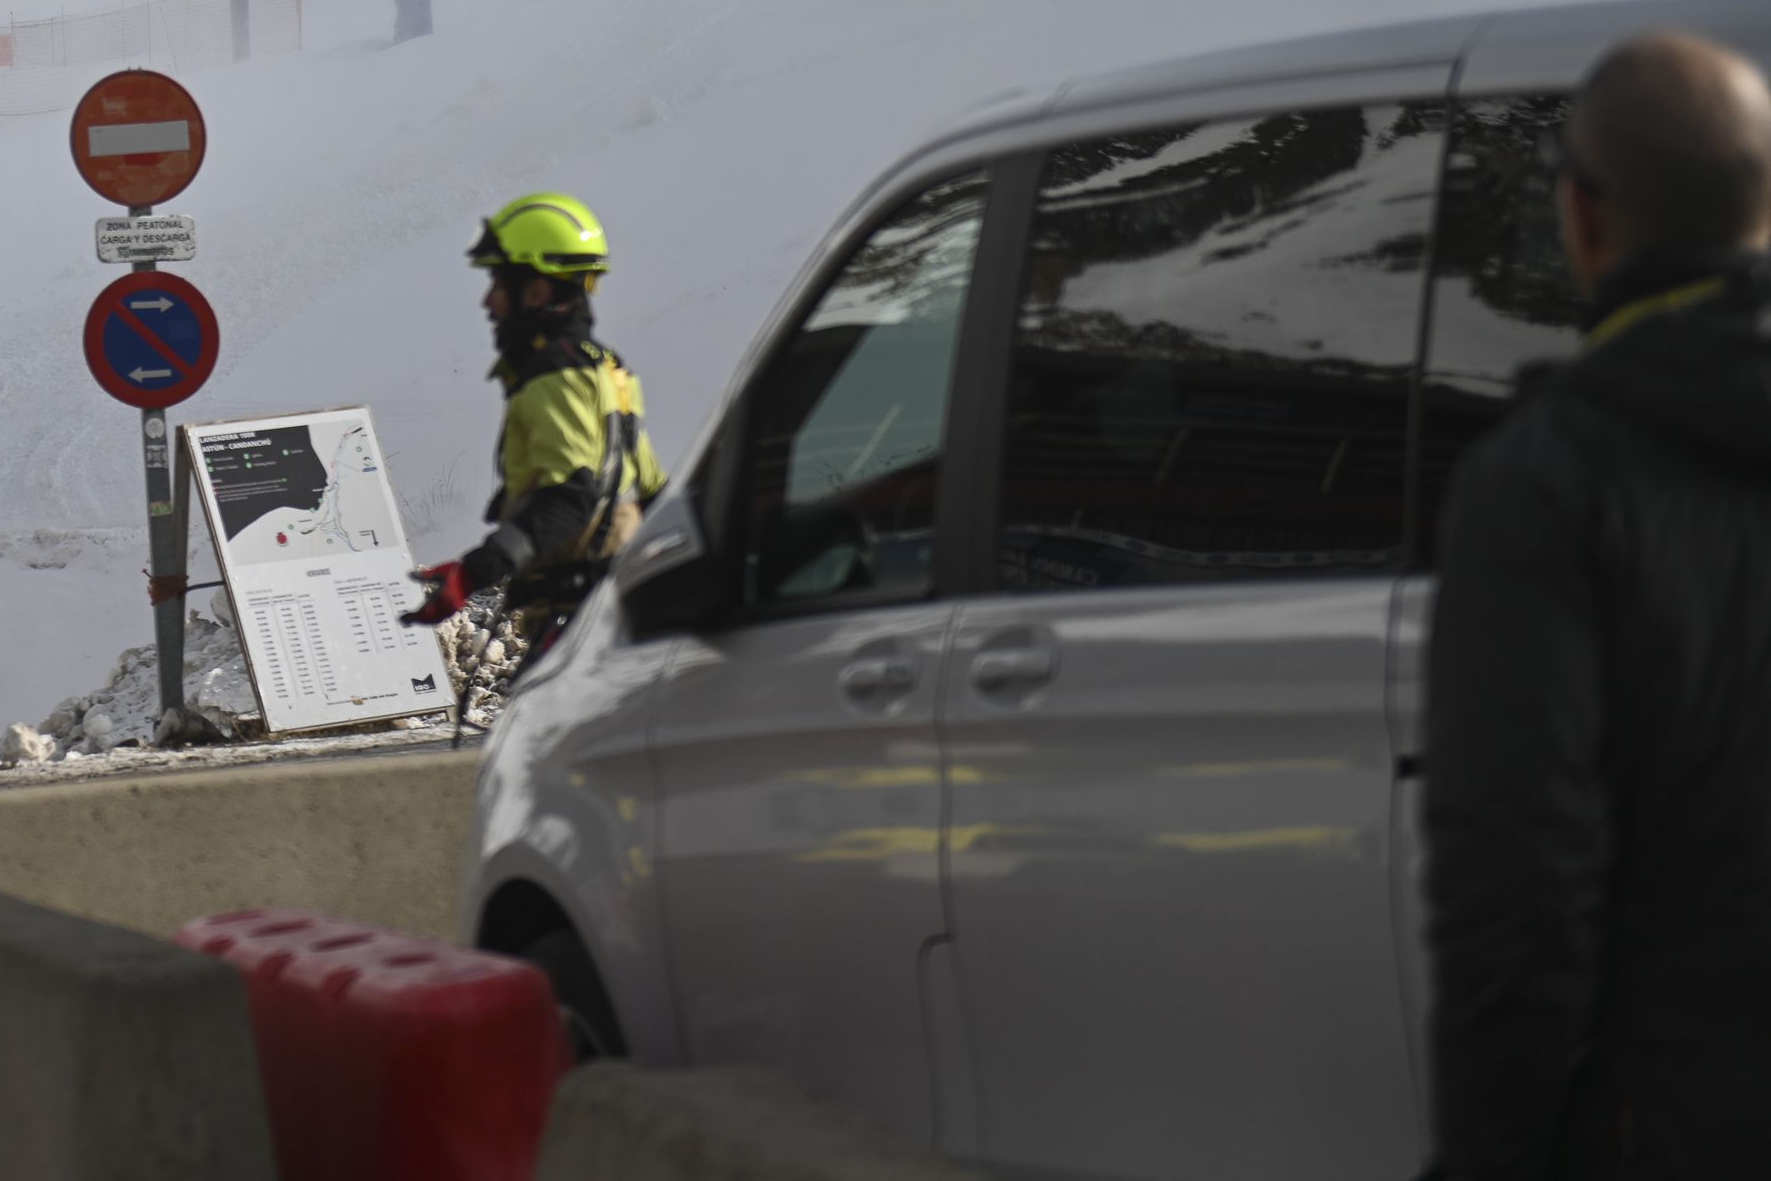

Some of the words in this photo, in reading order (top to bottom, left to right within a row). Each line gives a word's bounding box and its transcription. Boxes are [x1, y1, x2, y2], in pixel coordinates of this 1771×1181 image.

[106, 222, 132, 232] ZONA
[137, 220, 184, 230] PEATONAL
[100, 234, 132, 245] CARGA
[143, 232, 191, 244] DESCARGA
